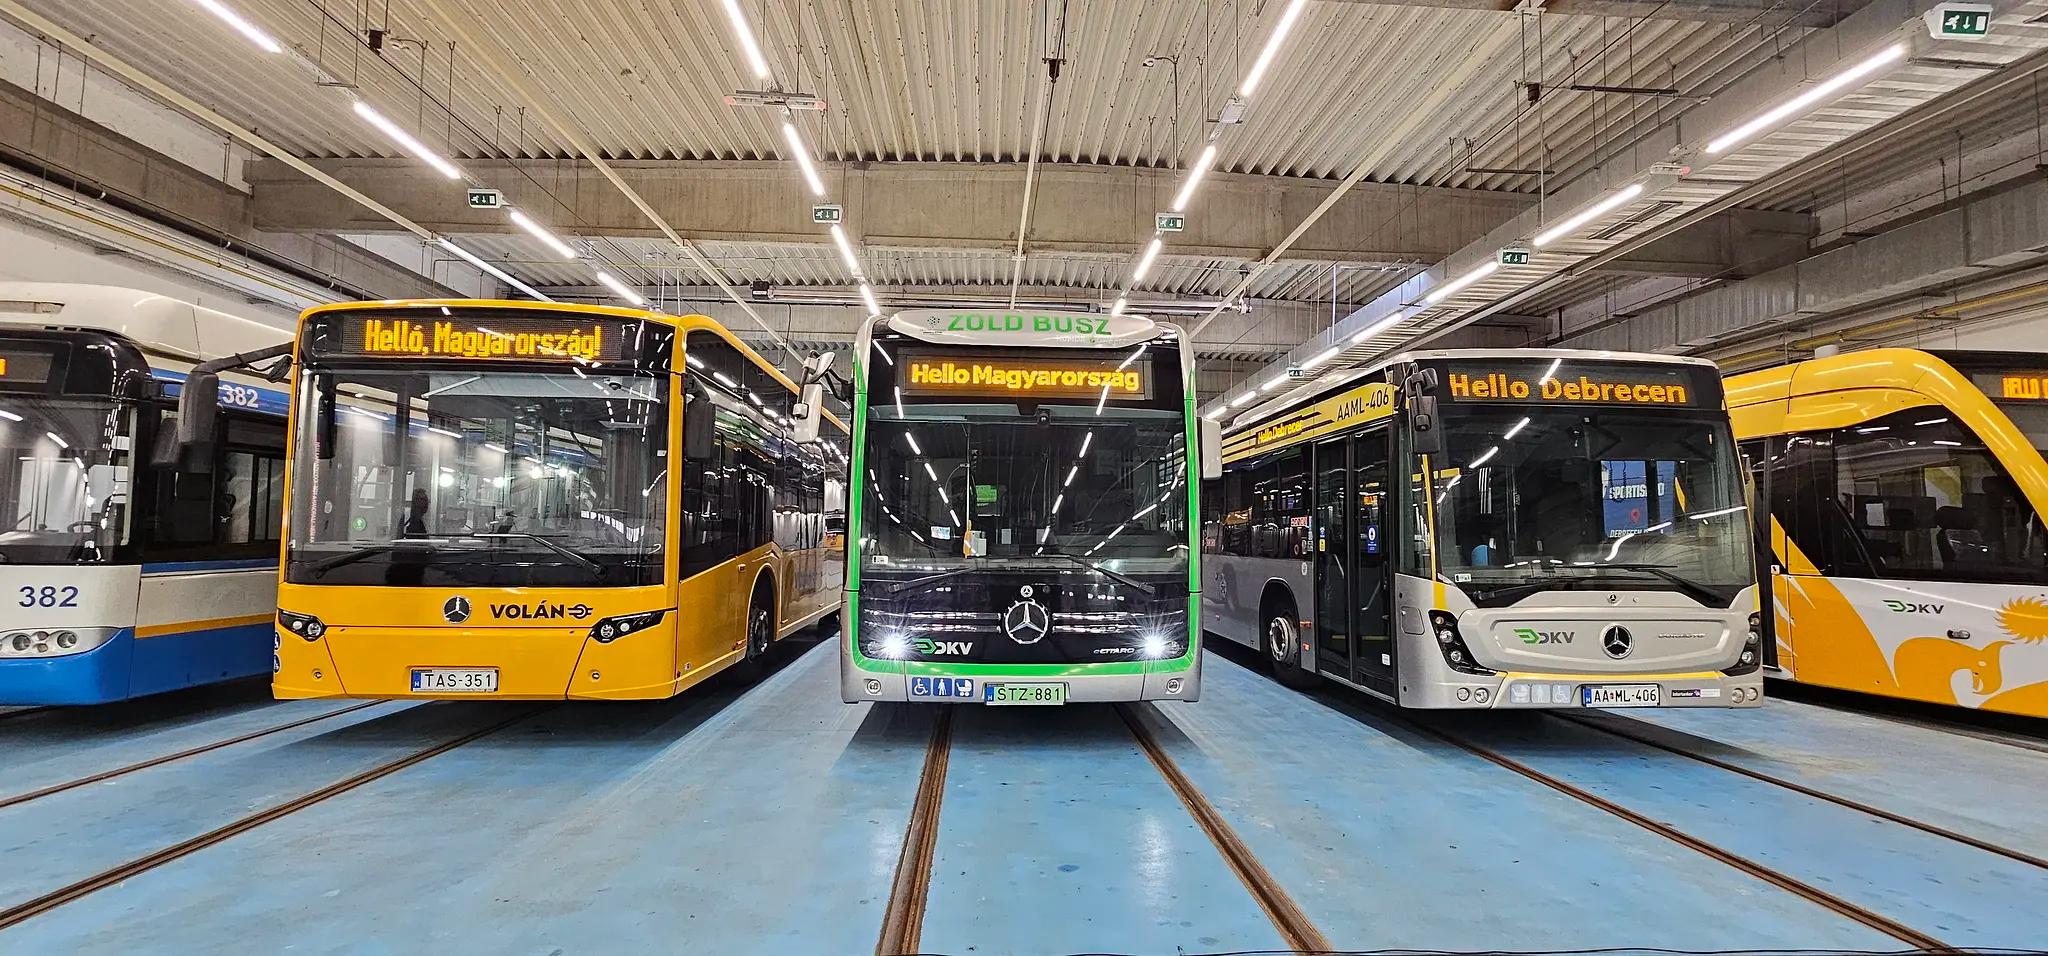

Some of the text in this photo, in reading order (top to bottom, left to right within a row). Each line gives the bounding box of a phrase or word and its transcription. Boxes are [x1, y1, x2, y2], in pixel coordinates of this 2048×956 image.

[1033, 315, 1112, 335] BUSZ
[365, 319, 602, 359] Helló, Magyarország!
[912, 363, 970, 384] Hello
[222, 385, 259, 408] 382
[1449, 374, 1687, 403] Hello Debrecen
[1337, 387, 1390, 422] AAML-406
[18, 585, 79, 608] 382
[490, 600, 565, 619] VOLÁN
[1906, 603, 1945, 615] DKV
[1538, 631, 1575, 644] DKV
[933, 641, 973, 656] DKV
[424, 674, 491, 687] TAS-351
[997, 687, 1060, 701] STZ-881
